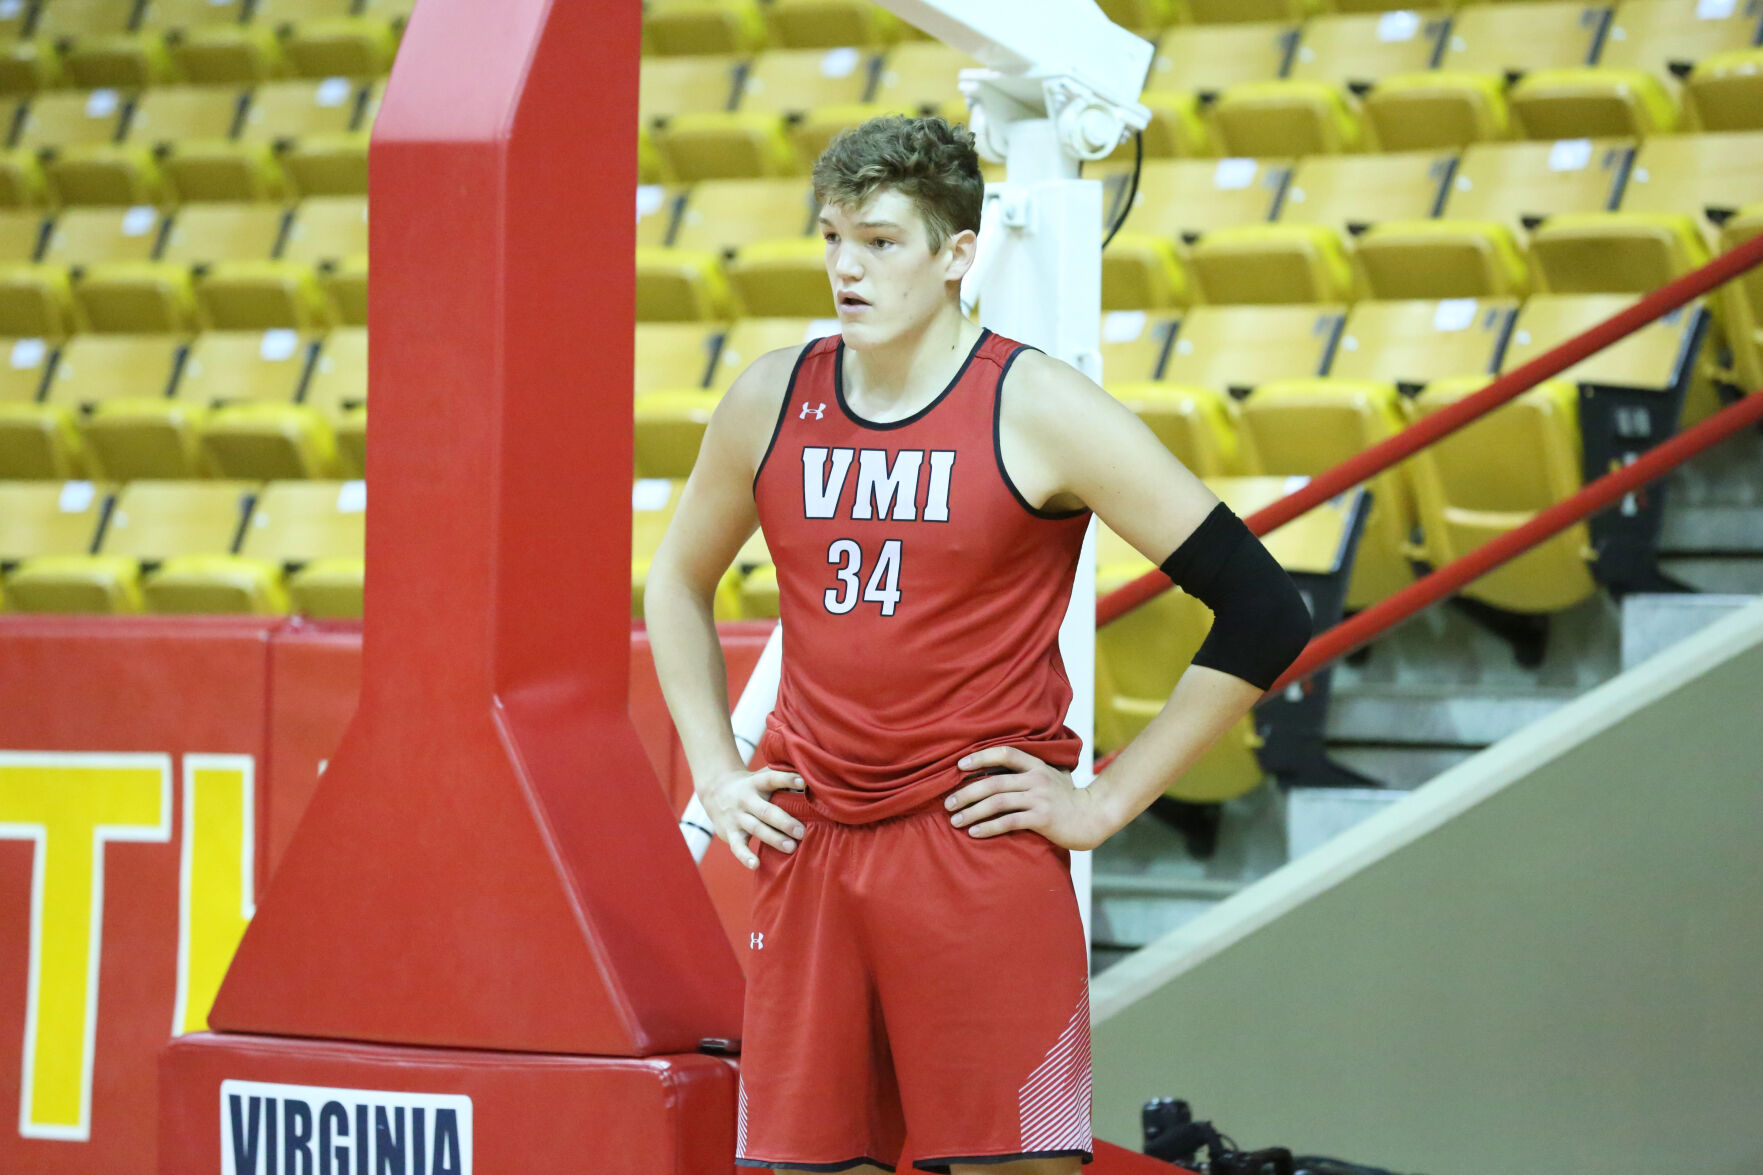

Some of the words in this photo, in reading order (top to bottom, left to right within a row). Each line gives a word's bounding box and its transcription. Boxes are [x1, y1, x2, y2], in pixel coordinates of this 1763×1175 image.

[801, 446, 956, 523] VMI
[823, 538, 902, 617] 34
[228, 1094, 462, 1175] VIRGINIA
